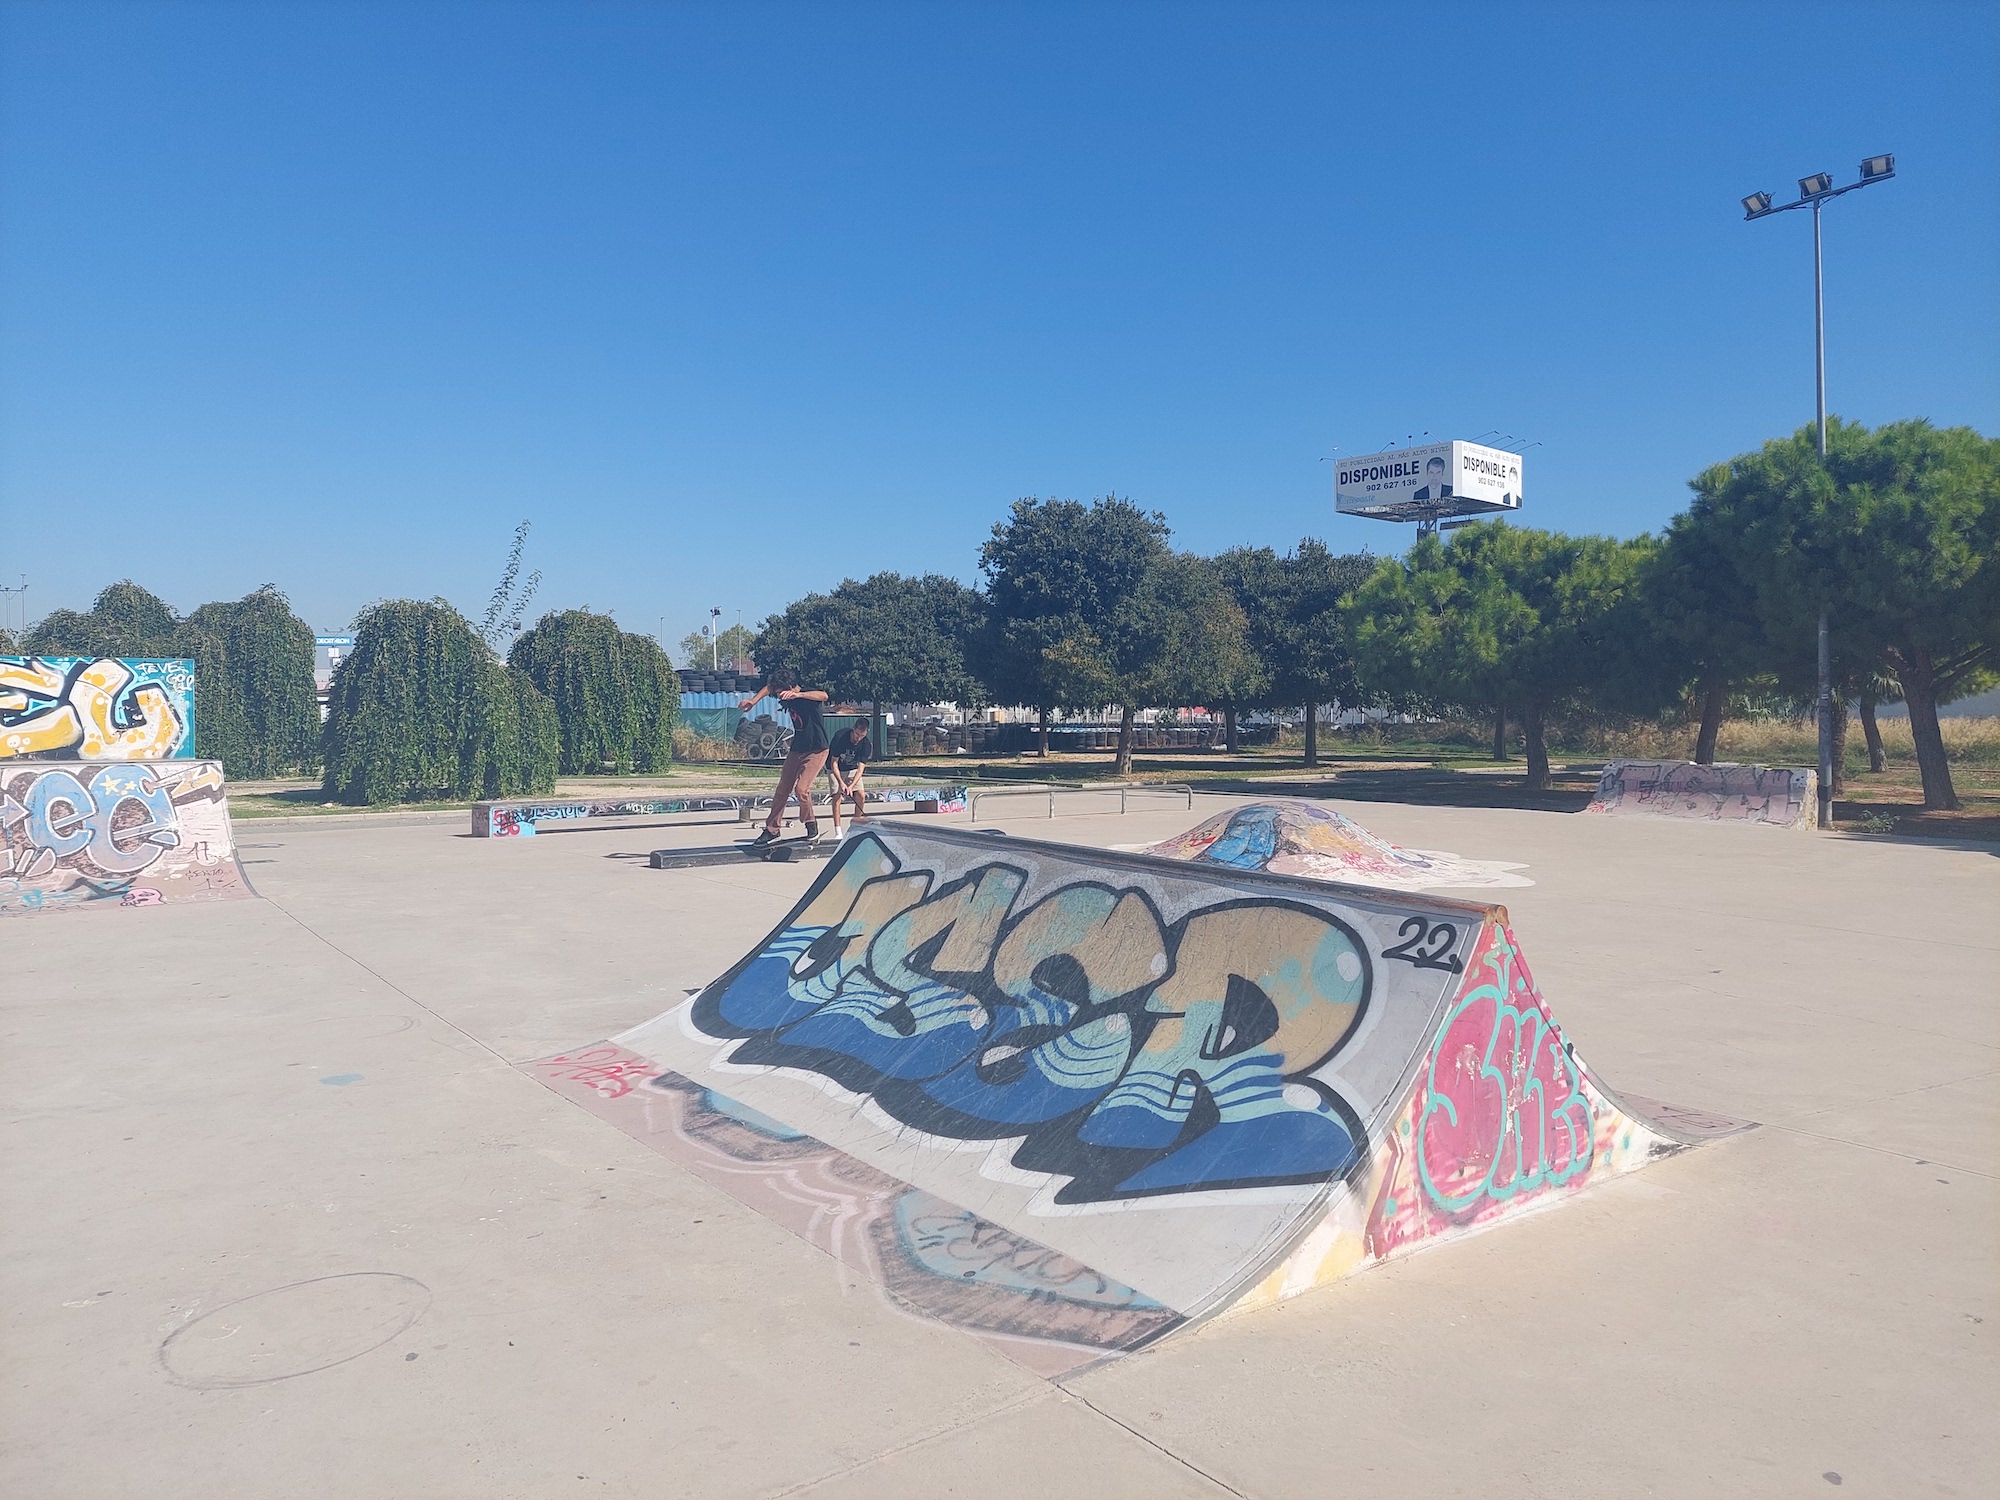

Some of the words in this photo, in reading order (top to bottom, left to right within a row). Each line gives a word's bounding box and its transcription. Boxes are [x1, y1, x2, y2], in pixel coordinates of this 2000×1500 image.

[1412, 448, 1428, 457] ALTO
[1430, 445, 1450, 454] NIVEL
[1340, 460, 1420, 485] DISPONIBLE
[1464, 456, 1506, 478] DISPONIBLE
[1366, 484, 1382, 492] 902
[1383, 481, 1399, 490] 627
[1402, 478, 1418, 488] 136
[1478, 476, 1487, 486] 902
[1488, 478, 1496, 487] 627
